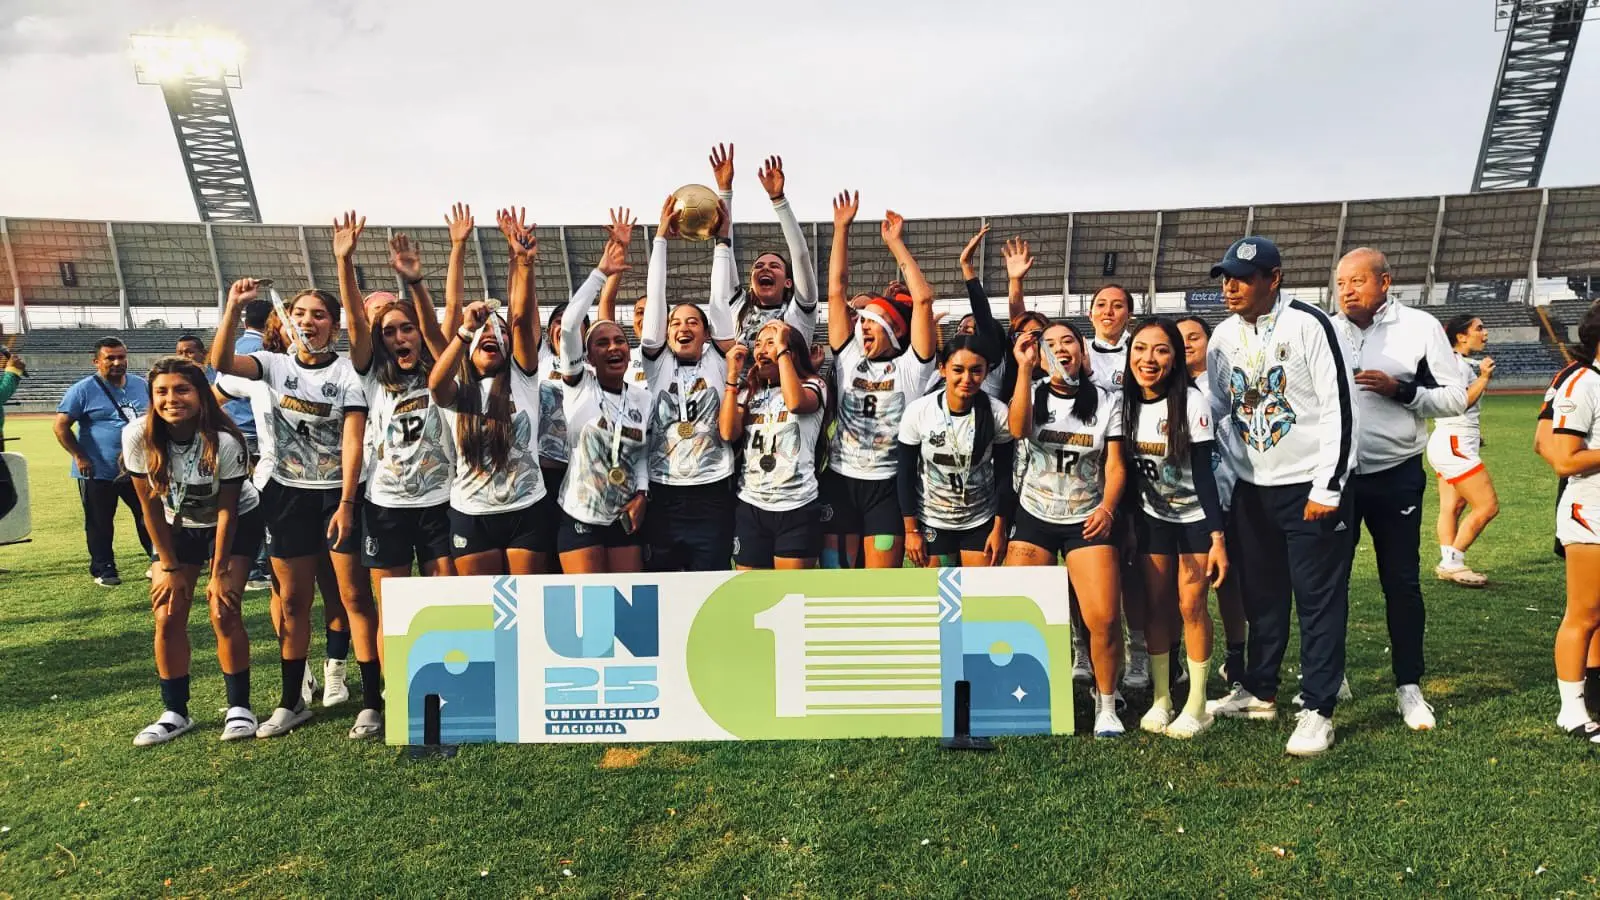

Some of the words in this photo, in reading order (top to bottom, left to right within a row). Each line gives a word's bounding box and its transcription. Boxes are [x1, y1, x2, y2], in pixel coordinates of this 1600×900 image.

[400, 416, 424, 442] 12
[1055, 449, 1080, 473] 17
[543, 585, 659, 658] UN
[545, 666, 659, 704] 25
[550, 709, 656, 719] UNIVERSIADA
[551, 724, 622, 734] NACIONAL
